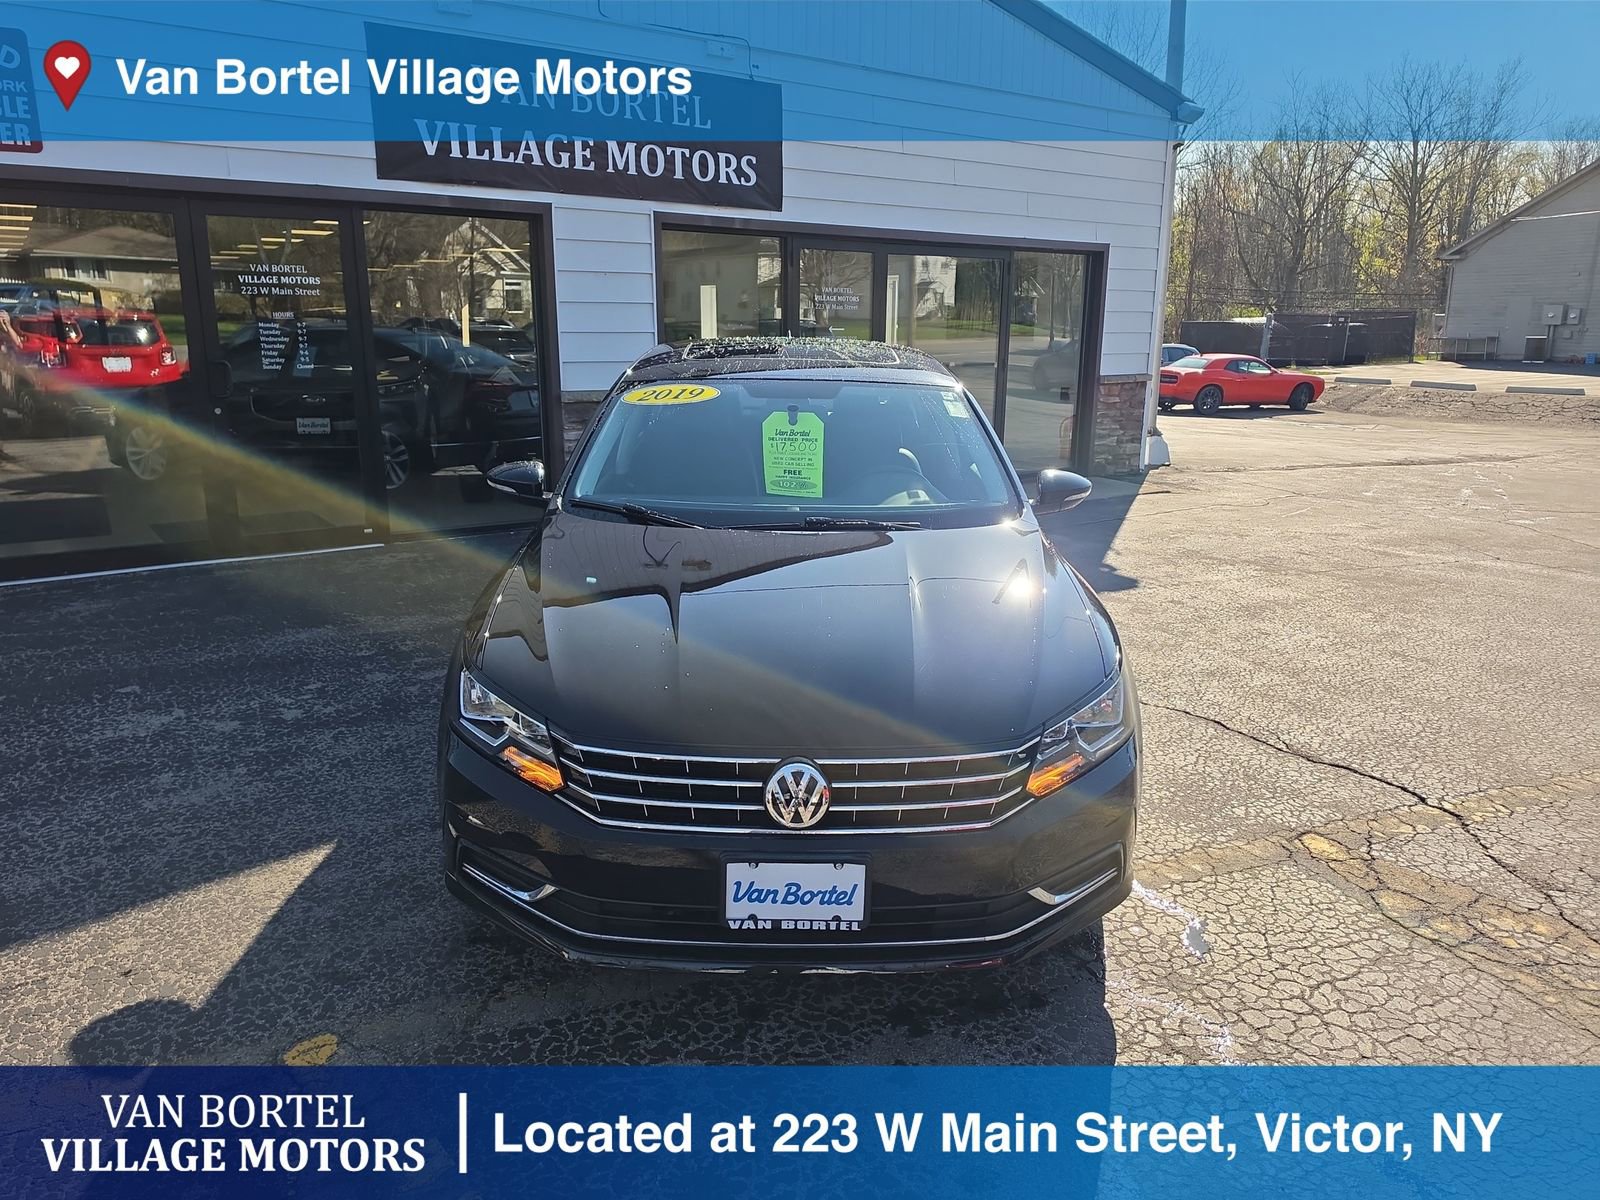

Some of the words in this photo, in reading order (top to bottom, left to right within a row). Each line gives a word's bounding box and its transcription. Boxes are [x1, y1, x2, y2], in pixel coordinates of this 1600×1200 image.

[414, 118, 596, 172] VILLAGE
[605, 139, 758, 187] MOTORS
[249, 263, 269, 272] VAN
[271, 264, 308, 274] BORTEL
[238, 275, 279, 284] VILLAGE
[280, 276, 321, 285] MOTORS
[240, 286, 258, 295] 223
[259, 286, 269, 295] W
[271, 286, 293, 295] Main
[294, 287, 320, 296] Street
[636, 387, 705, 402] 2019
[728, 920, 772, 930] VAN
[781, 920, 861, 931] BORTEL
